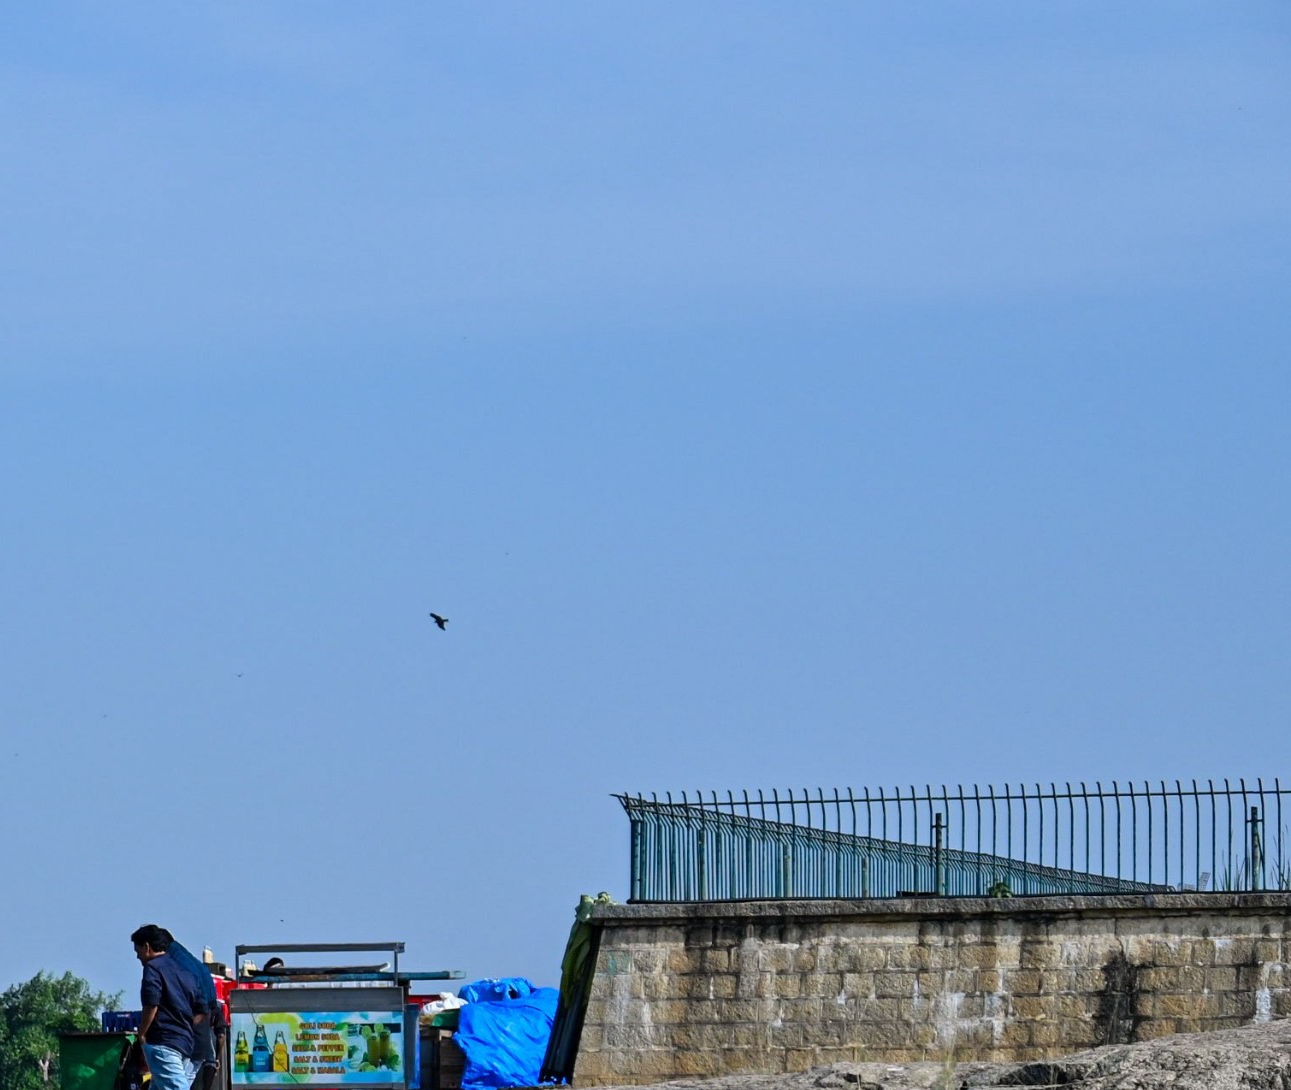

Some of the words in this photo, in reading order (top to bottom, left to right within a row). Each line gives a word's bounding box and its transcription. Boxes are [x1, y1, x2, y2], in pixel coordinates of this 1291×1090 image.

[295, 1033, 320, 1041] LEMON
[321, 1033, 341, 1041] SODA
[317, 1044, 345, 1052] PEPPER
[312, 1055, 318, 1063] &
[310, 1066, 316, 1074] &
